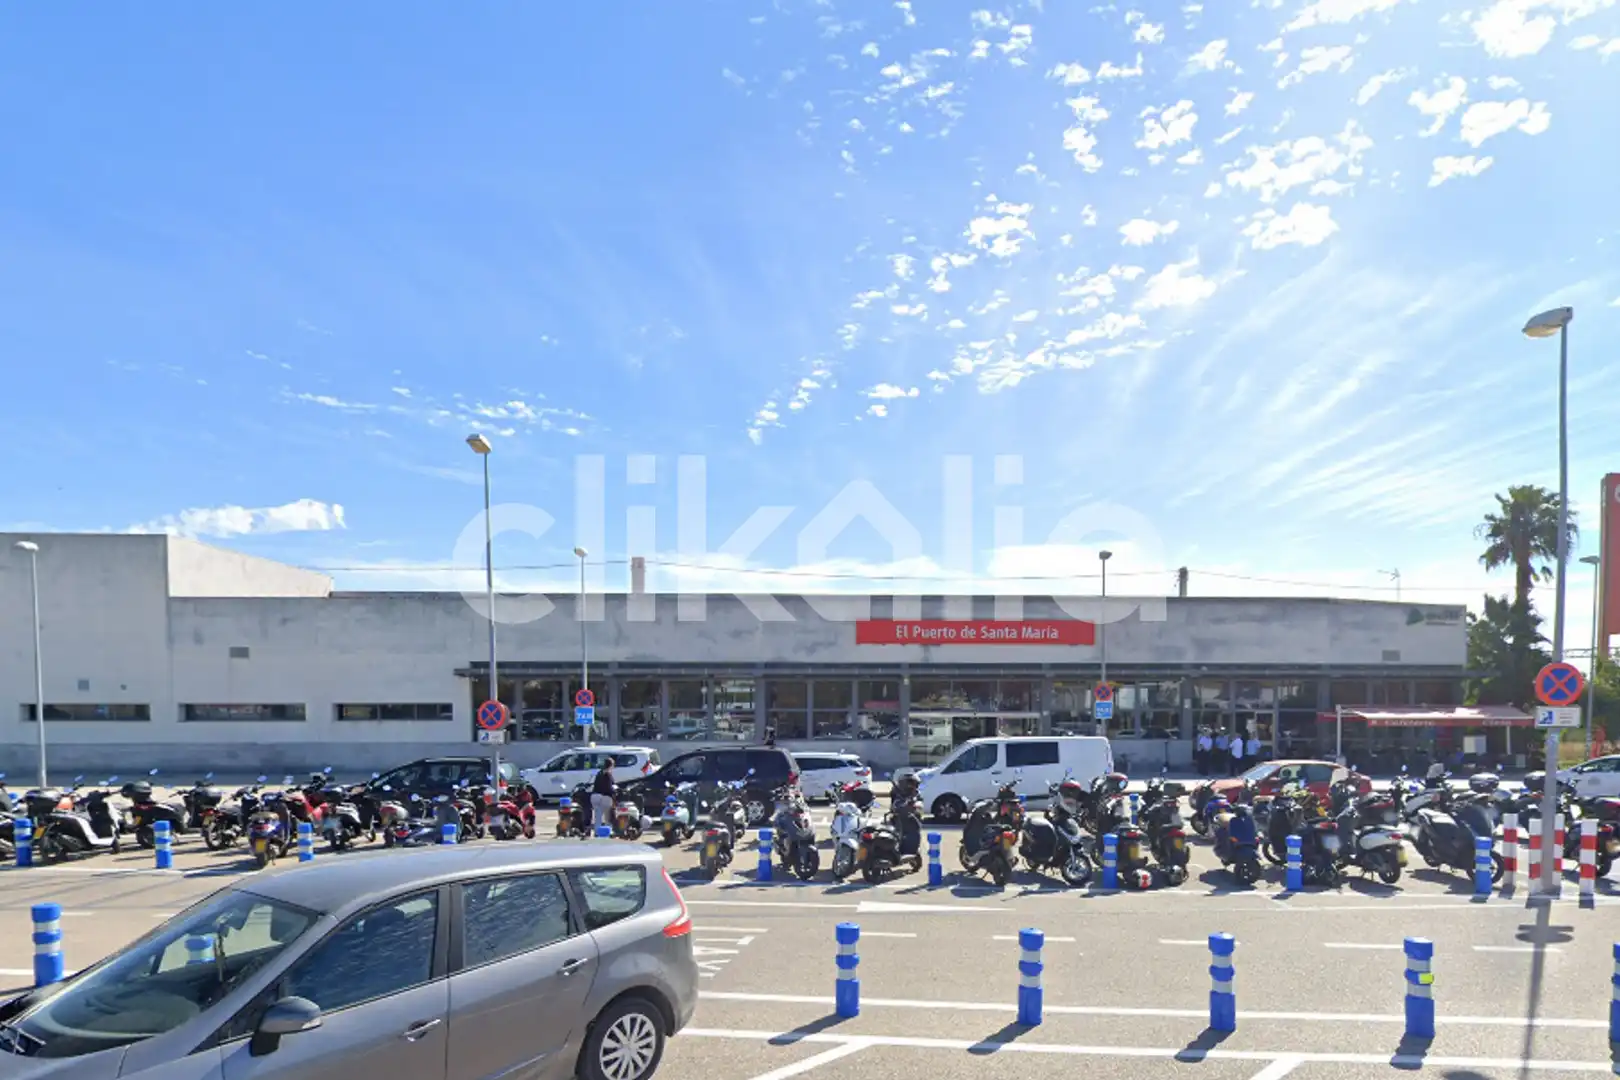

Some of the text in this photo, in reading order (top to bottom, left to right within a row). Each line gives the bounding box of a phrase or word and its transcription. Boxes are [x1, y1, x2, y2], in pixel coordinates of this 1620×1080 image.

[895, 624, 1059, 639] El Puerto de Santa María
